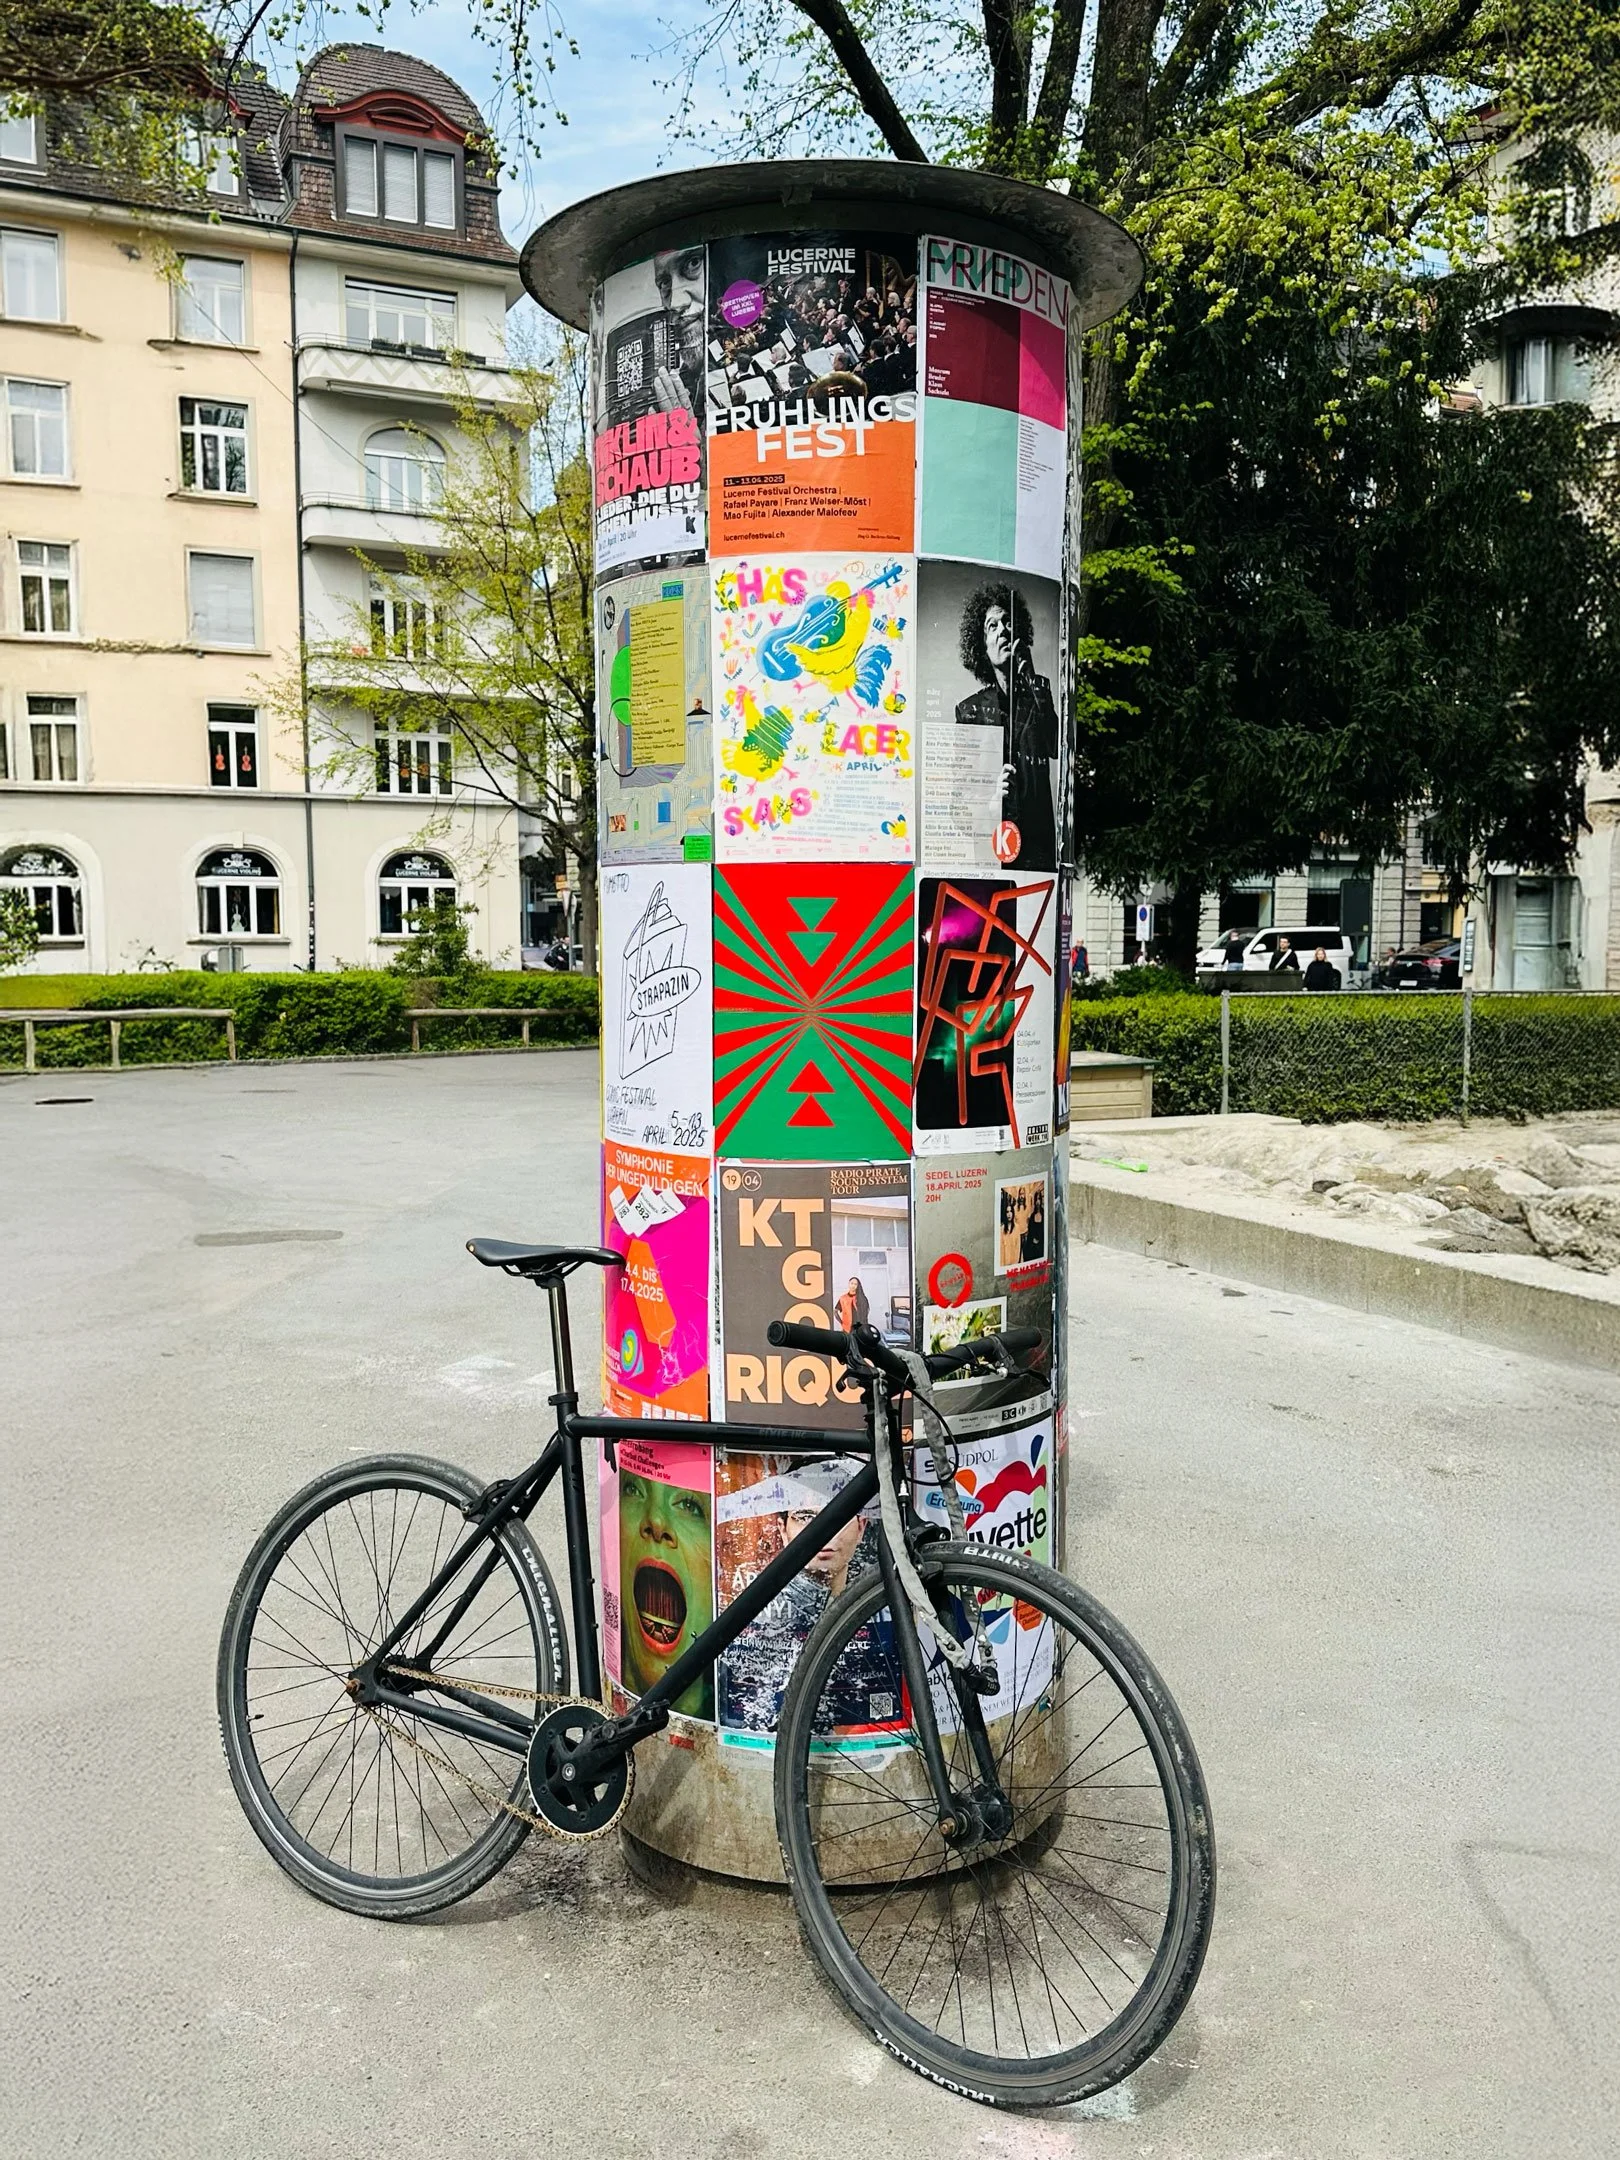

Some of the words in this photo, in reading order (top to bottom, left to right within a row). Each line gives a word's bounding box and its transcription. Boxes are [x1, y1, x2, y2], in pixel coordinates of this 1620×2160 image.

[767, 248, 856, 265] LUCERNE
[767, 259, 856, 276] FESTIVAL
[926, 237, 1070, 327] FRIEDEN
[731, 306, 756, 317] LUZERN
[707, 393, 918, 437] FRÜHLINGS
[757, 420, 875, 463] FEST
[638, 487, 667, 507] DIE
[669, 482, 701, 500] DU
[723, 489, 756, 499] Lucerne
[757, 486, 791, 497] Festival
[795, 484, 837, 495] Orchestra
[723, 498, 748, 509] Rafael
[750, 497, 779, 510] Payare
[784, 496, 808, 506] Franz
[723, 512, 742, 520] Mao
[743, 510, 767, 522] Fujita
[772, 508, 815, 518] Alexander
[816, 508, 858, 518] Malofeev
[723, 532, 785, 542] lucernefestival.ch
[715, 565, 808, 612] CHÄS
[820, 722, 912, 762] LAGER
[846, 761, 883, 772] APRIL
[996, 824, 1012, 856] K
[637, 972, 690, 1010] STRAPAZIN
[621, 1086, 657, 1107] FESTIVAL
[642, 1125, 668, 1145] APRIL
[673, 1127, 708, 1147] 2025
[727, 1176, 737, 1185] 19
[744, 1176, 759, 1187] 04
[830, 1170, 863, 1178] RADIO
[866, 1168, 902, 1176] PIRATE
[830, 1178, 867, 1187] SOUND
[868, 1175, 907, 1185] SYSTEM
[926, 1170, 953, 1180] SEDEL
[956, 1168, 988, 1177] LUZERN
[831, 1186, 860, 1195] TOUR
[965, 1180, 982, 1188] 2025
[925, 1194, 941, 1202] 20H
[739, 1198, 824, 1247] KT
[642, 1266, 658, 1283] bis
[781, 1250, 824, 1300] G
[620, 1279, 664, 1303] 17.4.2025
